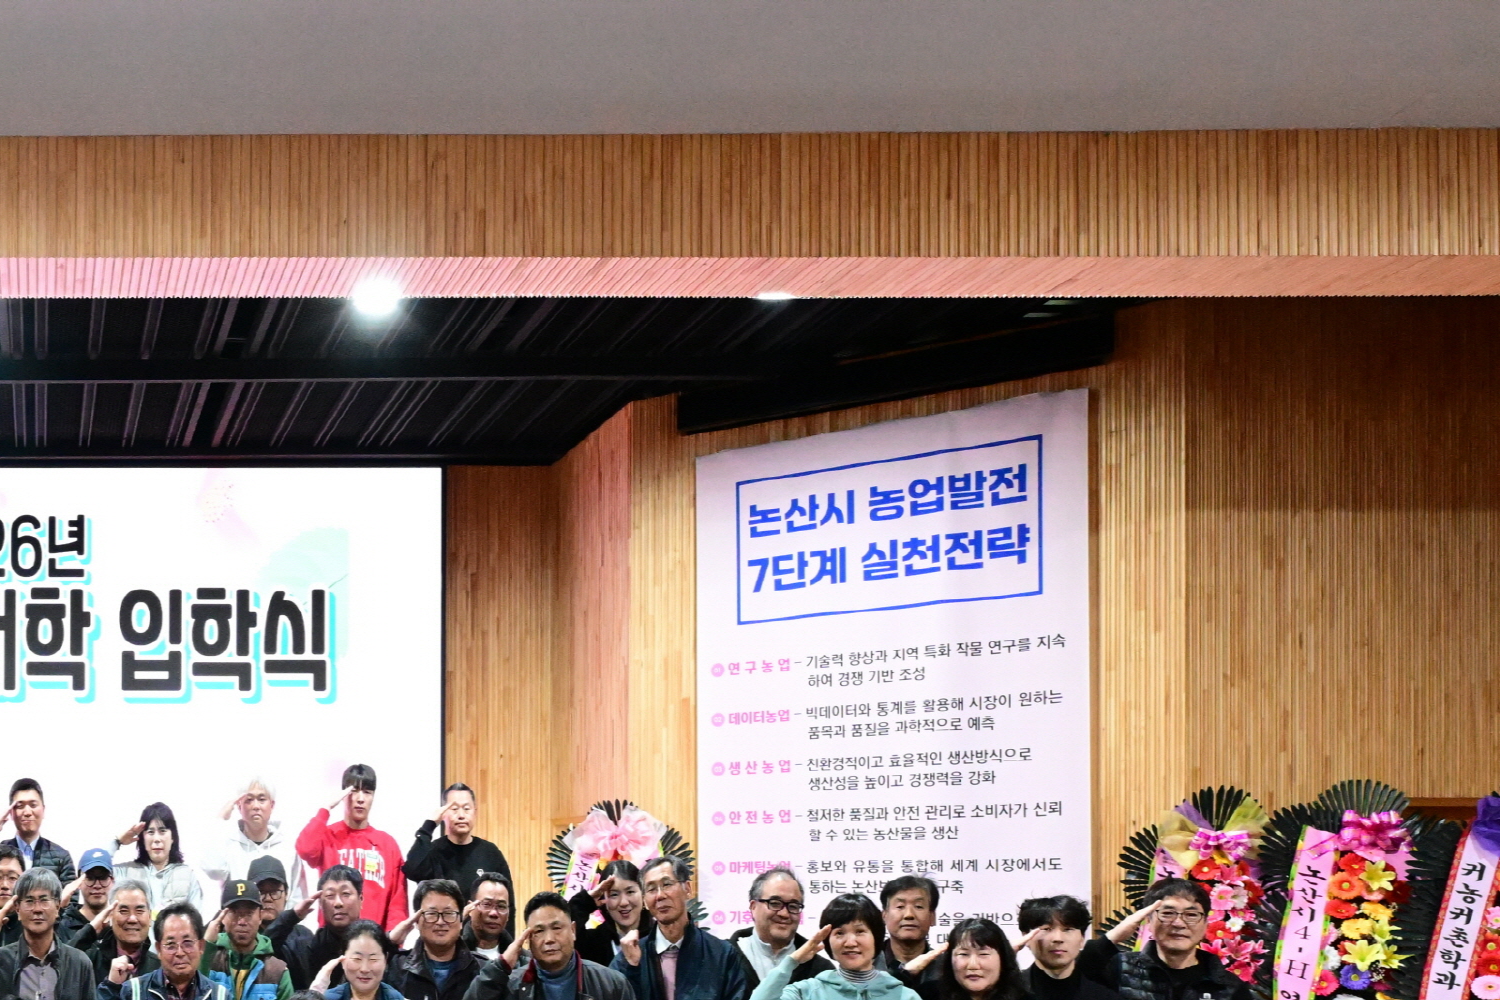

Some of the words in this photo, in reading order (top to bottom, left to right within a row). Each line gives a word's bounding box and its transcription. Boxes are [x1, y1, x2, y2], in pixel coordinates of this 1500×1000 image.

[748, 489, 855, 539] 논산시
[868, 463, 1028, 522] 농업발전
[747, 545, 847, 594] 7단계
[861, 522, 1031, 582] 실천전략
[119, 586, 328, 693] 입학식
[806, 653, 843, 668] 기술력
[848, 650, 888, 666] 향상과
[892, 647, 919, 661] 지역
[924, 643, 951, 658] 특화
[956, 641, 983, 657] 작물
[988, 637, 1032, 654] 연구를
[1037, 633, 1067, 650] 지속
[808, 673, 833, 687] 하여
[838, 671, 863, 687] 경쟁
[869, 669, 894, 683] 기반
[899, 667, 925, 681] 조성
[728, 709, 790, 725] 데이터농업
[806, 703, 871, 719] 빅데이터와
[876, 701, 917, 717] 통계를
[922, 697, 964, 713] 활용해
[969, 694, 1012, 710] 시장이
[1018, 689, 1063, 707] 원하는
[808, 724, 845, 740] 품목과
[851, 722, 890, 738] 품질을
[895, 718, 963, 734] 과학적으로
[967, 716, 995, 731] 예측
[806, 755, 884, 772] 친환경적이고
[888, 751, 942, 767] 효율적인
[947, 748, 1033, 765] 생산방식으로
[808, 775, 860, 791] 생산성을
[864, 774, 904, 790] 높이고
[909, 771, 963, 788] 경쟁력을
[968, 770, 996, 786] 강화
[806, 808, 845, 822] 철저한
[849, 807, 888, 822] 품질과
[893, 805, 920, 821] 안전
[924, 804, 966, 820] 관리로
[970, 802, 1028, 818] 소비자가
[1033, 800, 1063, 817] 신뢰
[809, 828, 821, 842] 할
[825, 829, 838, 841] 수
[843, 828, 868, 841] 있는
[873, 826, 927, 841] 농산물을
[931, 826, 959, 840] 생산
[807, 860, 847, 874] 홍보와
[853, 859, 894, 873] 유통을
[901, 859, 944, 873] 통합해
[950, 859, 978, 872] 세계
[985, 857, 1063, 872] 시장에서도
[236, 883, 246, 896] P
[809, 880, 847, 895] 통하는
[938, 880, 964, 895] 구축
[1432, 861, 1486, 990] 귀농귀촌학과
